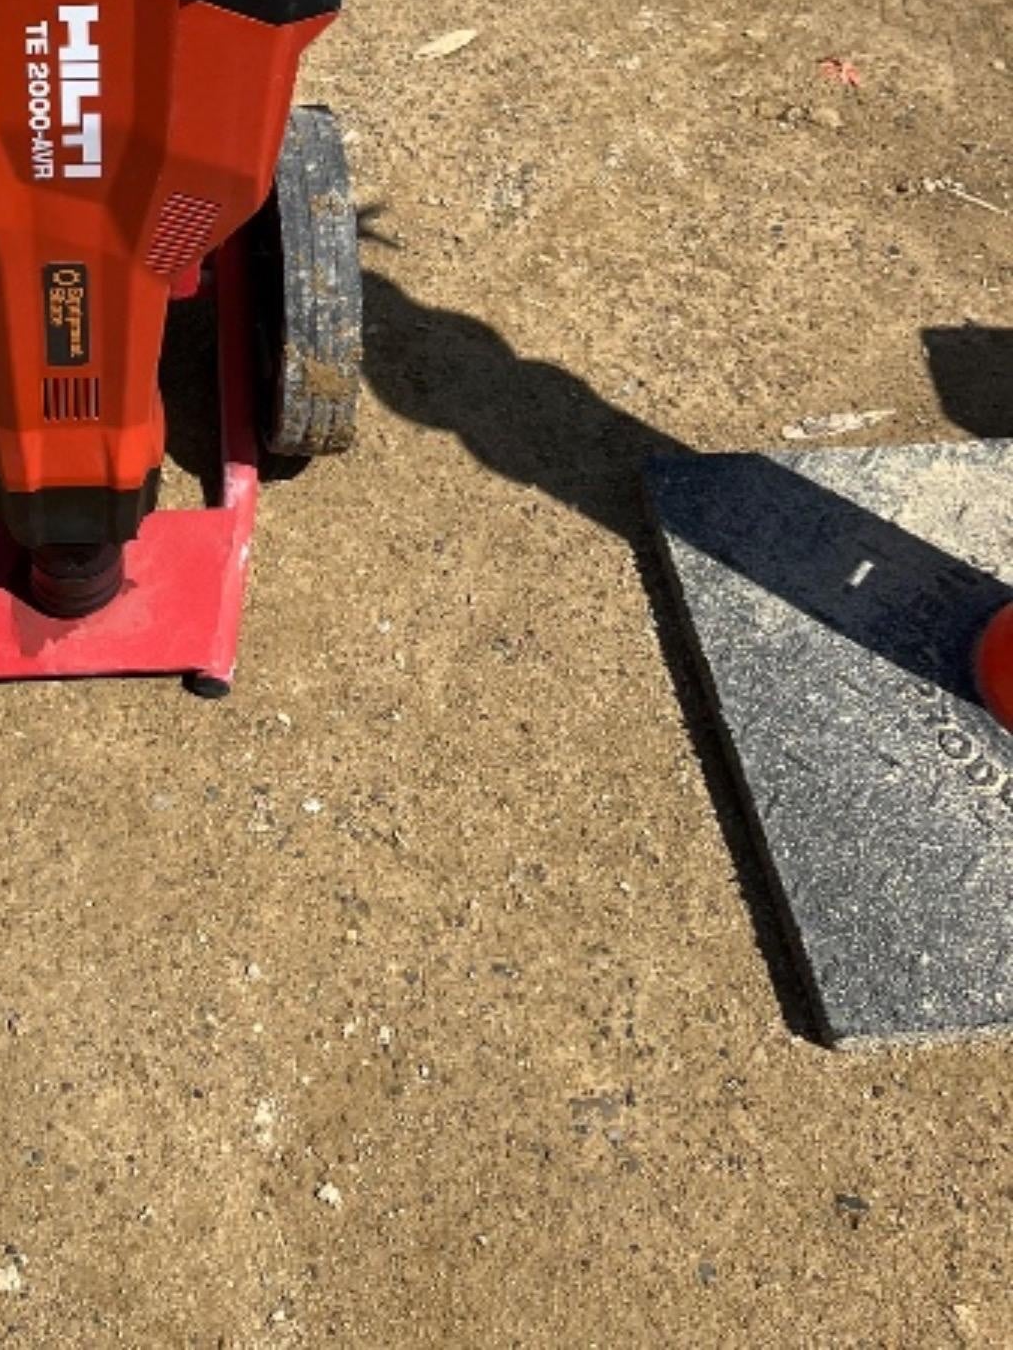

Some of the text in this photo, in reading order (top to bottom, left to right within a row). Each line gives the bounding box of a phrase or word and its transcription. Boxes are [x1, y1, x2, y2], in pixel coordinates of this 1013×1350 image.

[24, 20, 55, 180] TE 2000-AVR
[58, 4, 101, 178] HILTI
